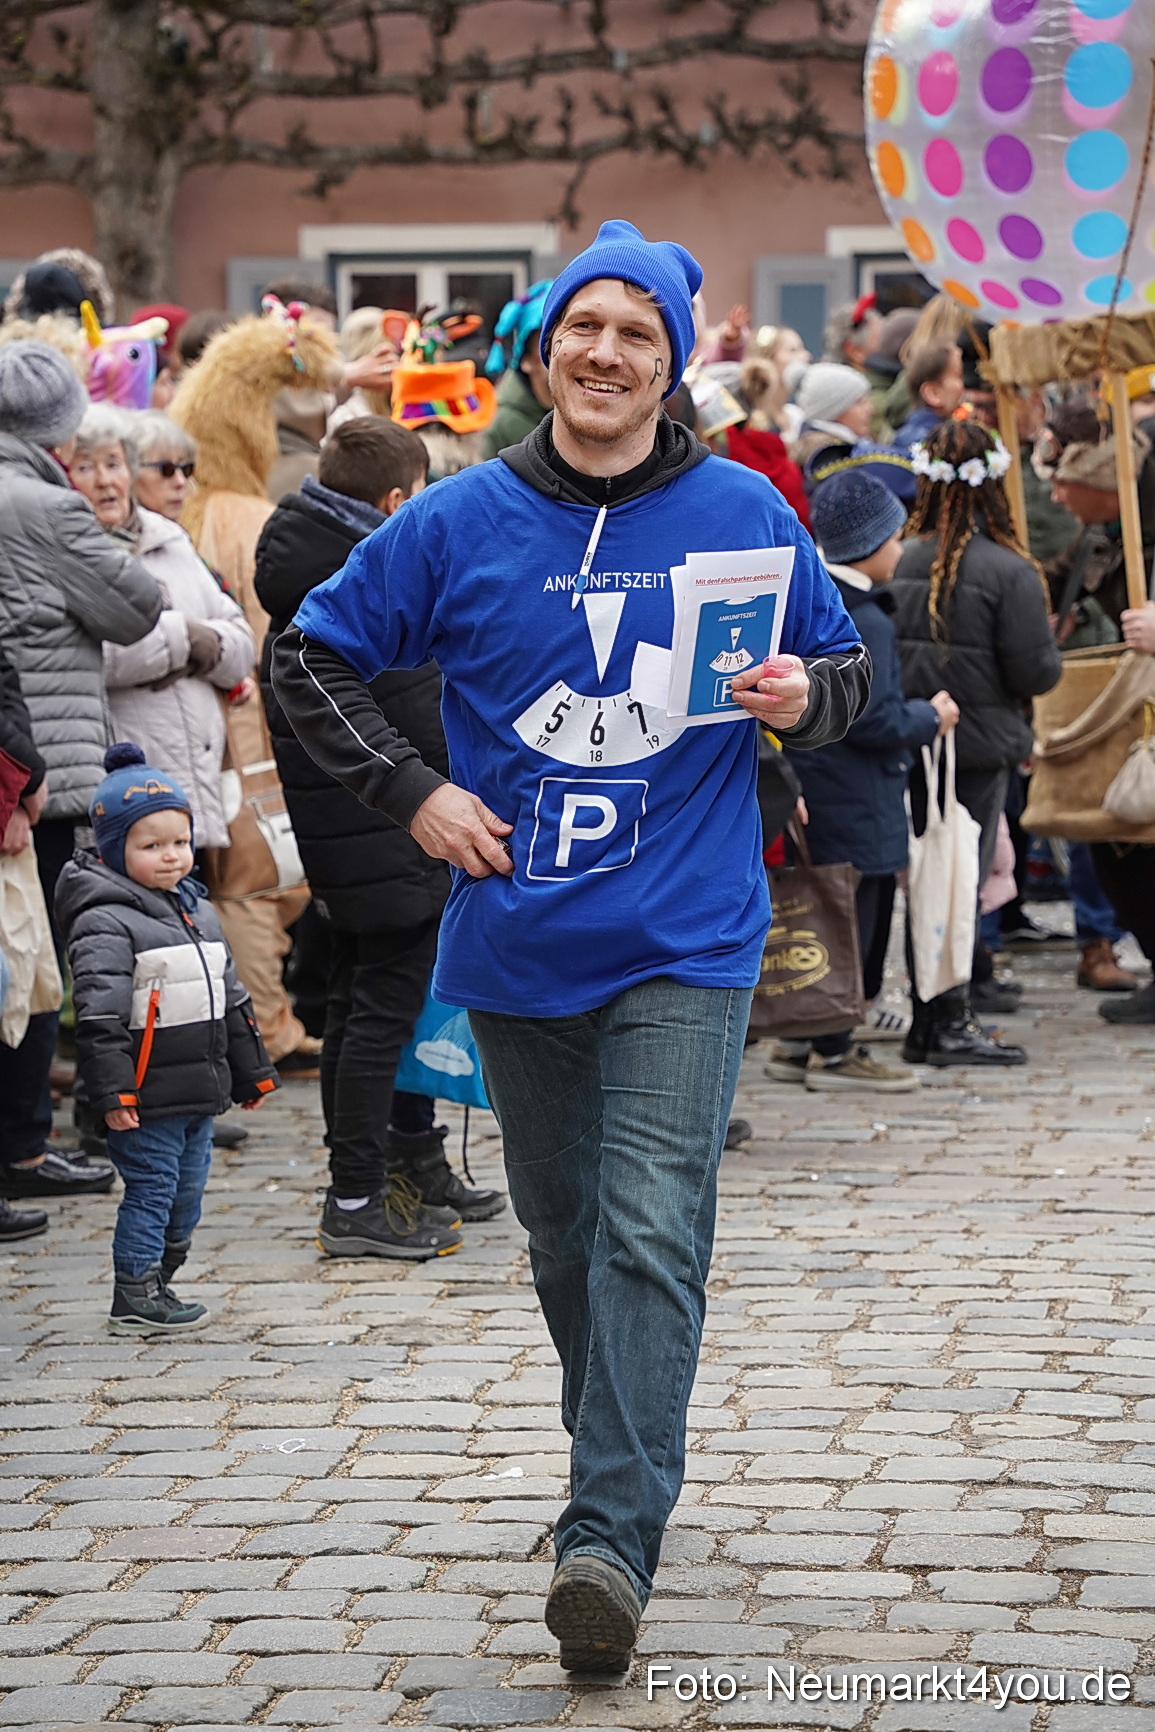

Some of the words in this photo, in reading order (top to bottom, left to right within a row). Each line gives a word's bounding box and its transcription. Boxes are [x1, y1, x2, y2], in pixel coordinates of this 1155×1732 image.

[718, 611, 758, 622] ANKUNFTSZEIT
[724, 656, 732, 666] 11
[735, 653, 744, 664] 12
[545, 701, 571, 733] 5
[590, 711, 605, 746] 6
[627, 701, 648, 735] 7
[536, 734, 551, 748] 17
[590, 750, 603, 763] 18
[646, 735, 660, 749] 19
[555, 793, 618, 868] P
